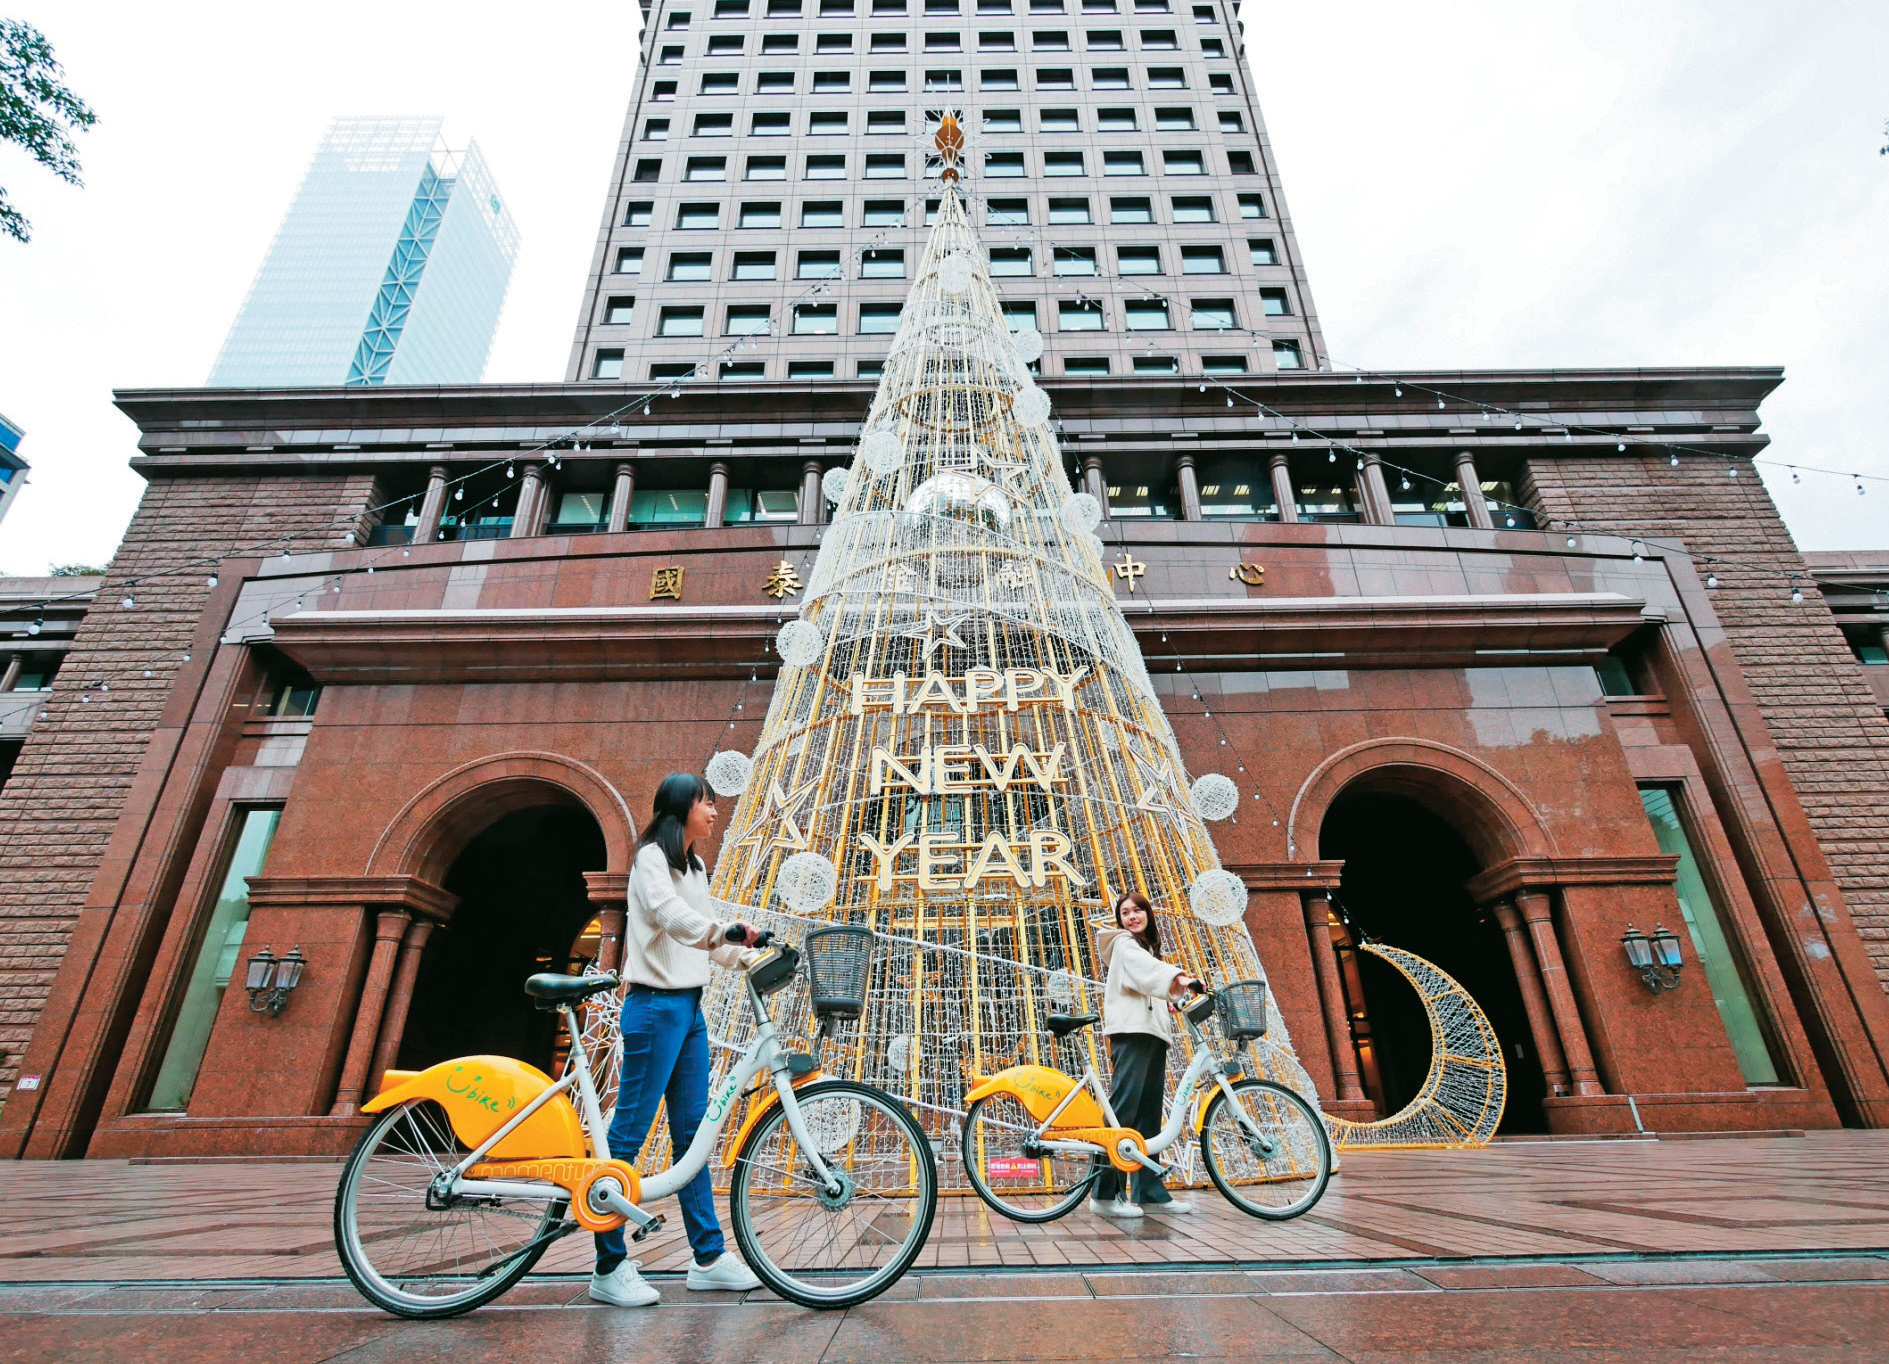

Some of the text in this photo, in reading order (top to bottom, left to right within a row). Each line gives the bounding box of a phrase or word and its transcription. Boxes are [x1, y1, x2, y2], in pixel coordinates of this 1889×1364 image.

[851, 666, 1090, 715] HAPPY
[870, 742, 1067, 795] NEW
[859, 830, 1086, 891] YEAR
